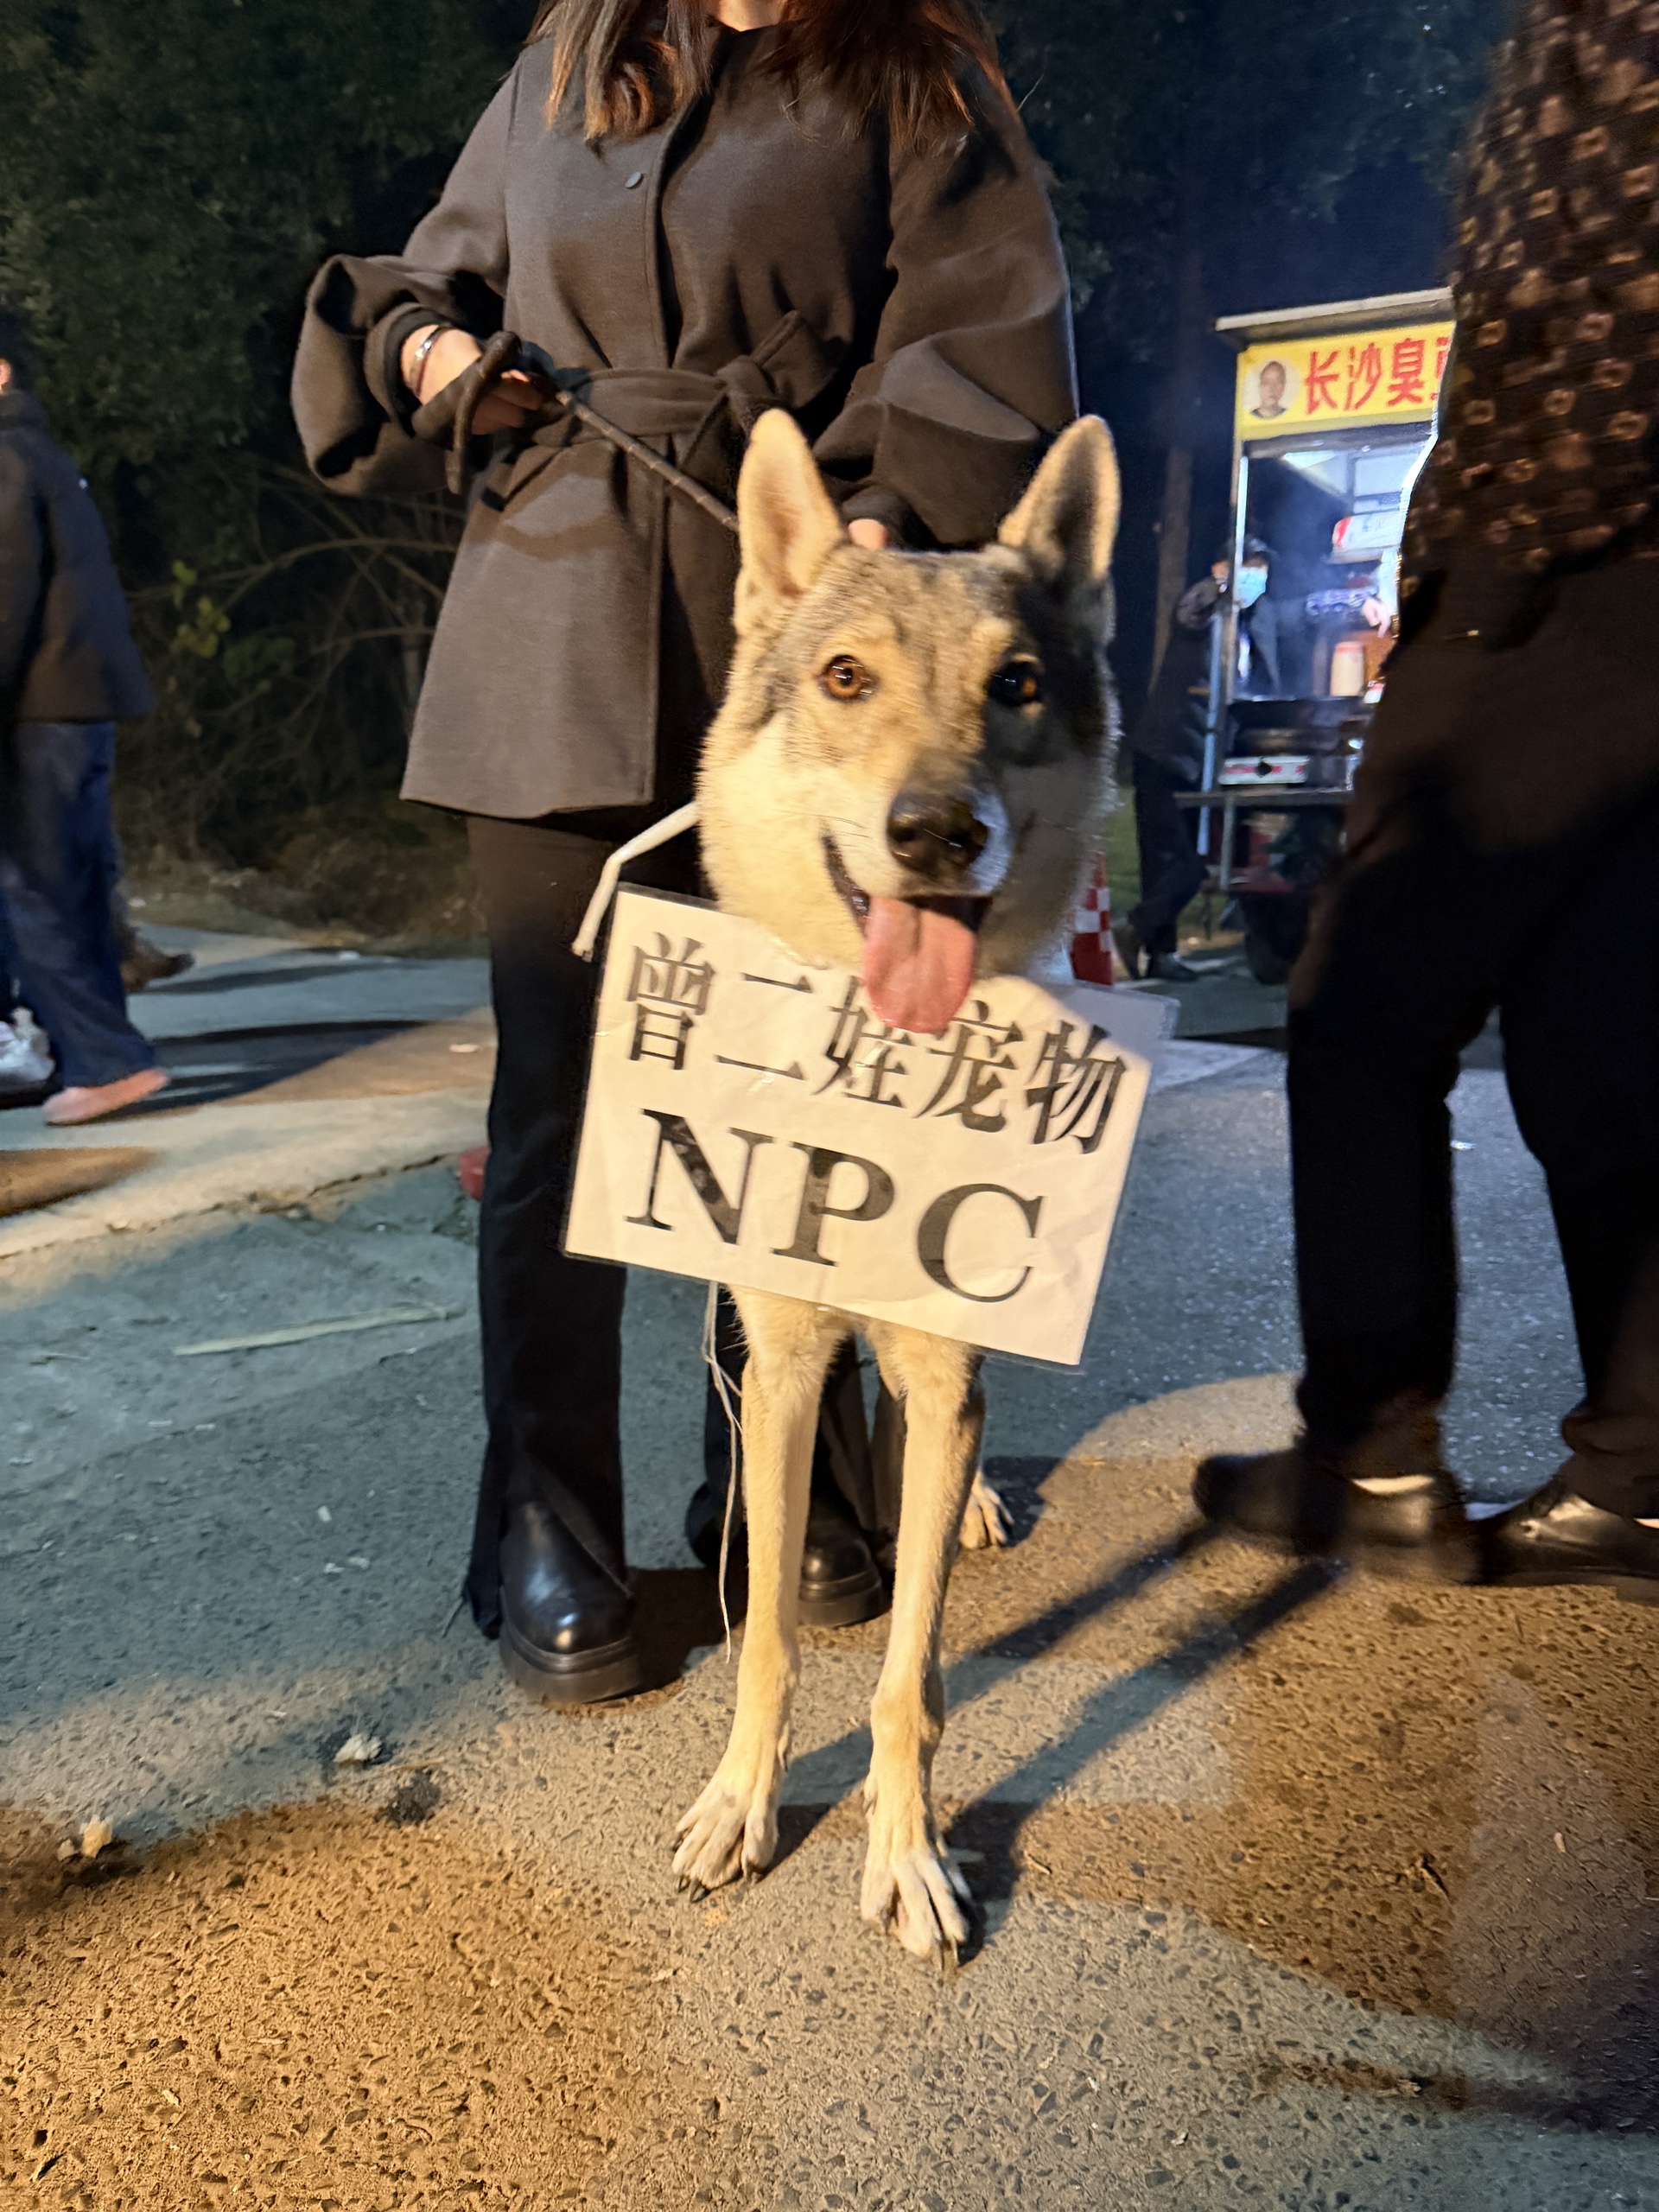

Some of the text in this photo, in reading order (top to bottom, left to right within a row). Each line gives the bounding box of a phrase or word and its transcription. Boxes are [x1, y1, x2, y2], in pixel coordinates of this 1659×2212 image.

[626, 931, 1127, 1154] 曾二娃宠物
[624, 1108, 1048, 1303] NPC
